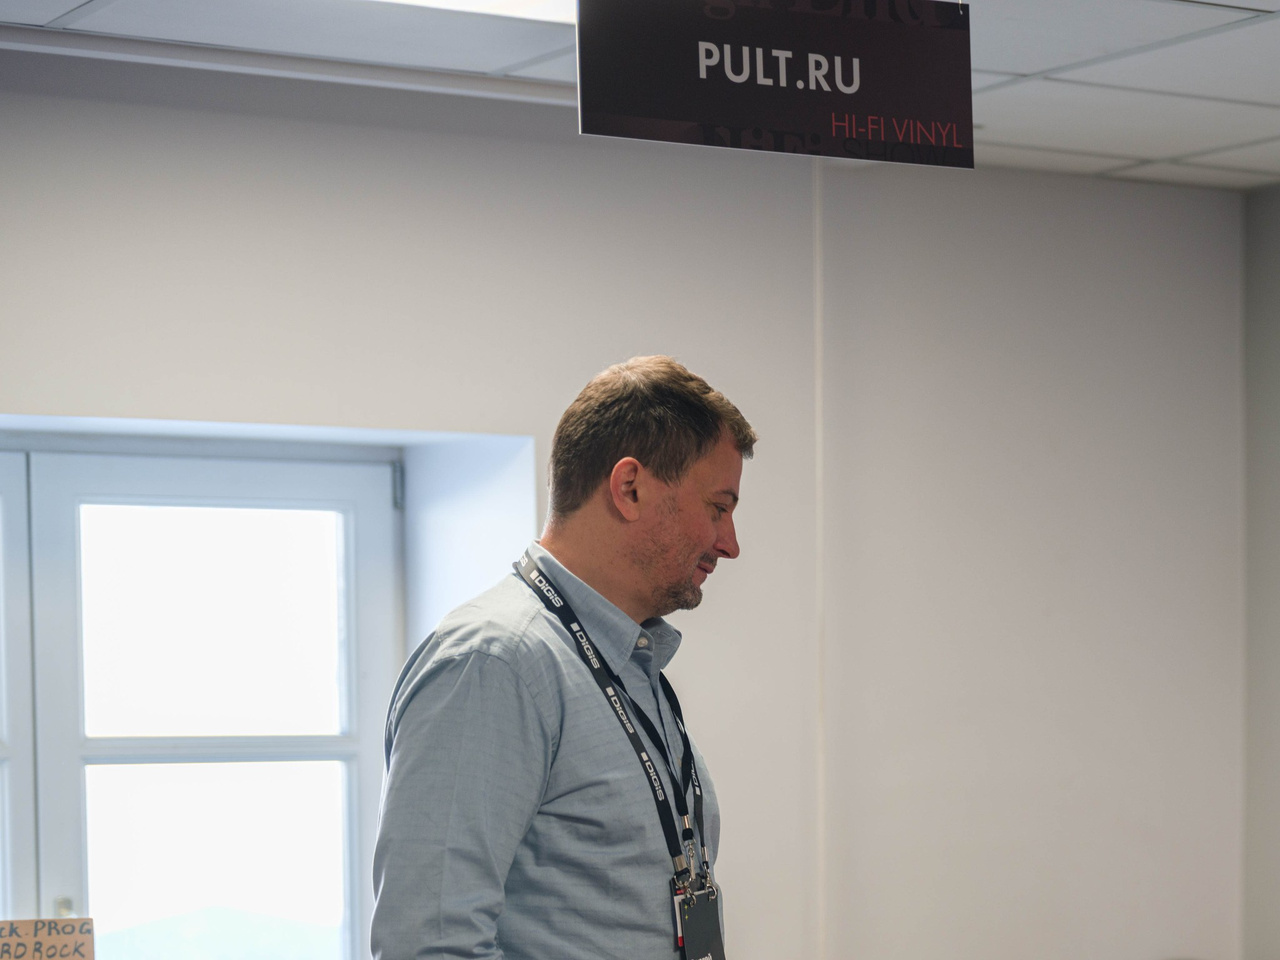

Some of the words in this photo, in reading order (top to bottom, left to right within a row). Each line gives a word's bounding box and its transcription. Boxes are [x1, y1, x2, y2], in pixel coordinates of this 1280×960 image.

[698, 41, 861, 94] PULT.RU
[831, 112, 886, 142] HI-FI
[892, 117, 963, 149] VINYL
[33, 920, 92, 938] PROG
[32, 941, 85, 960] ROCK
